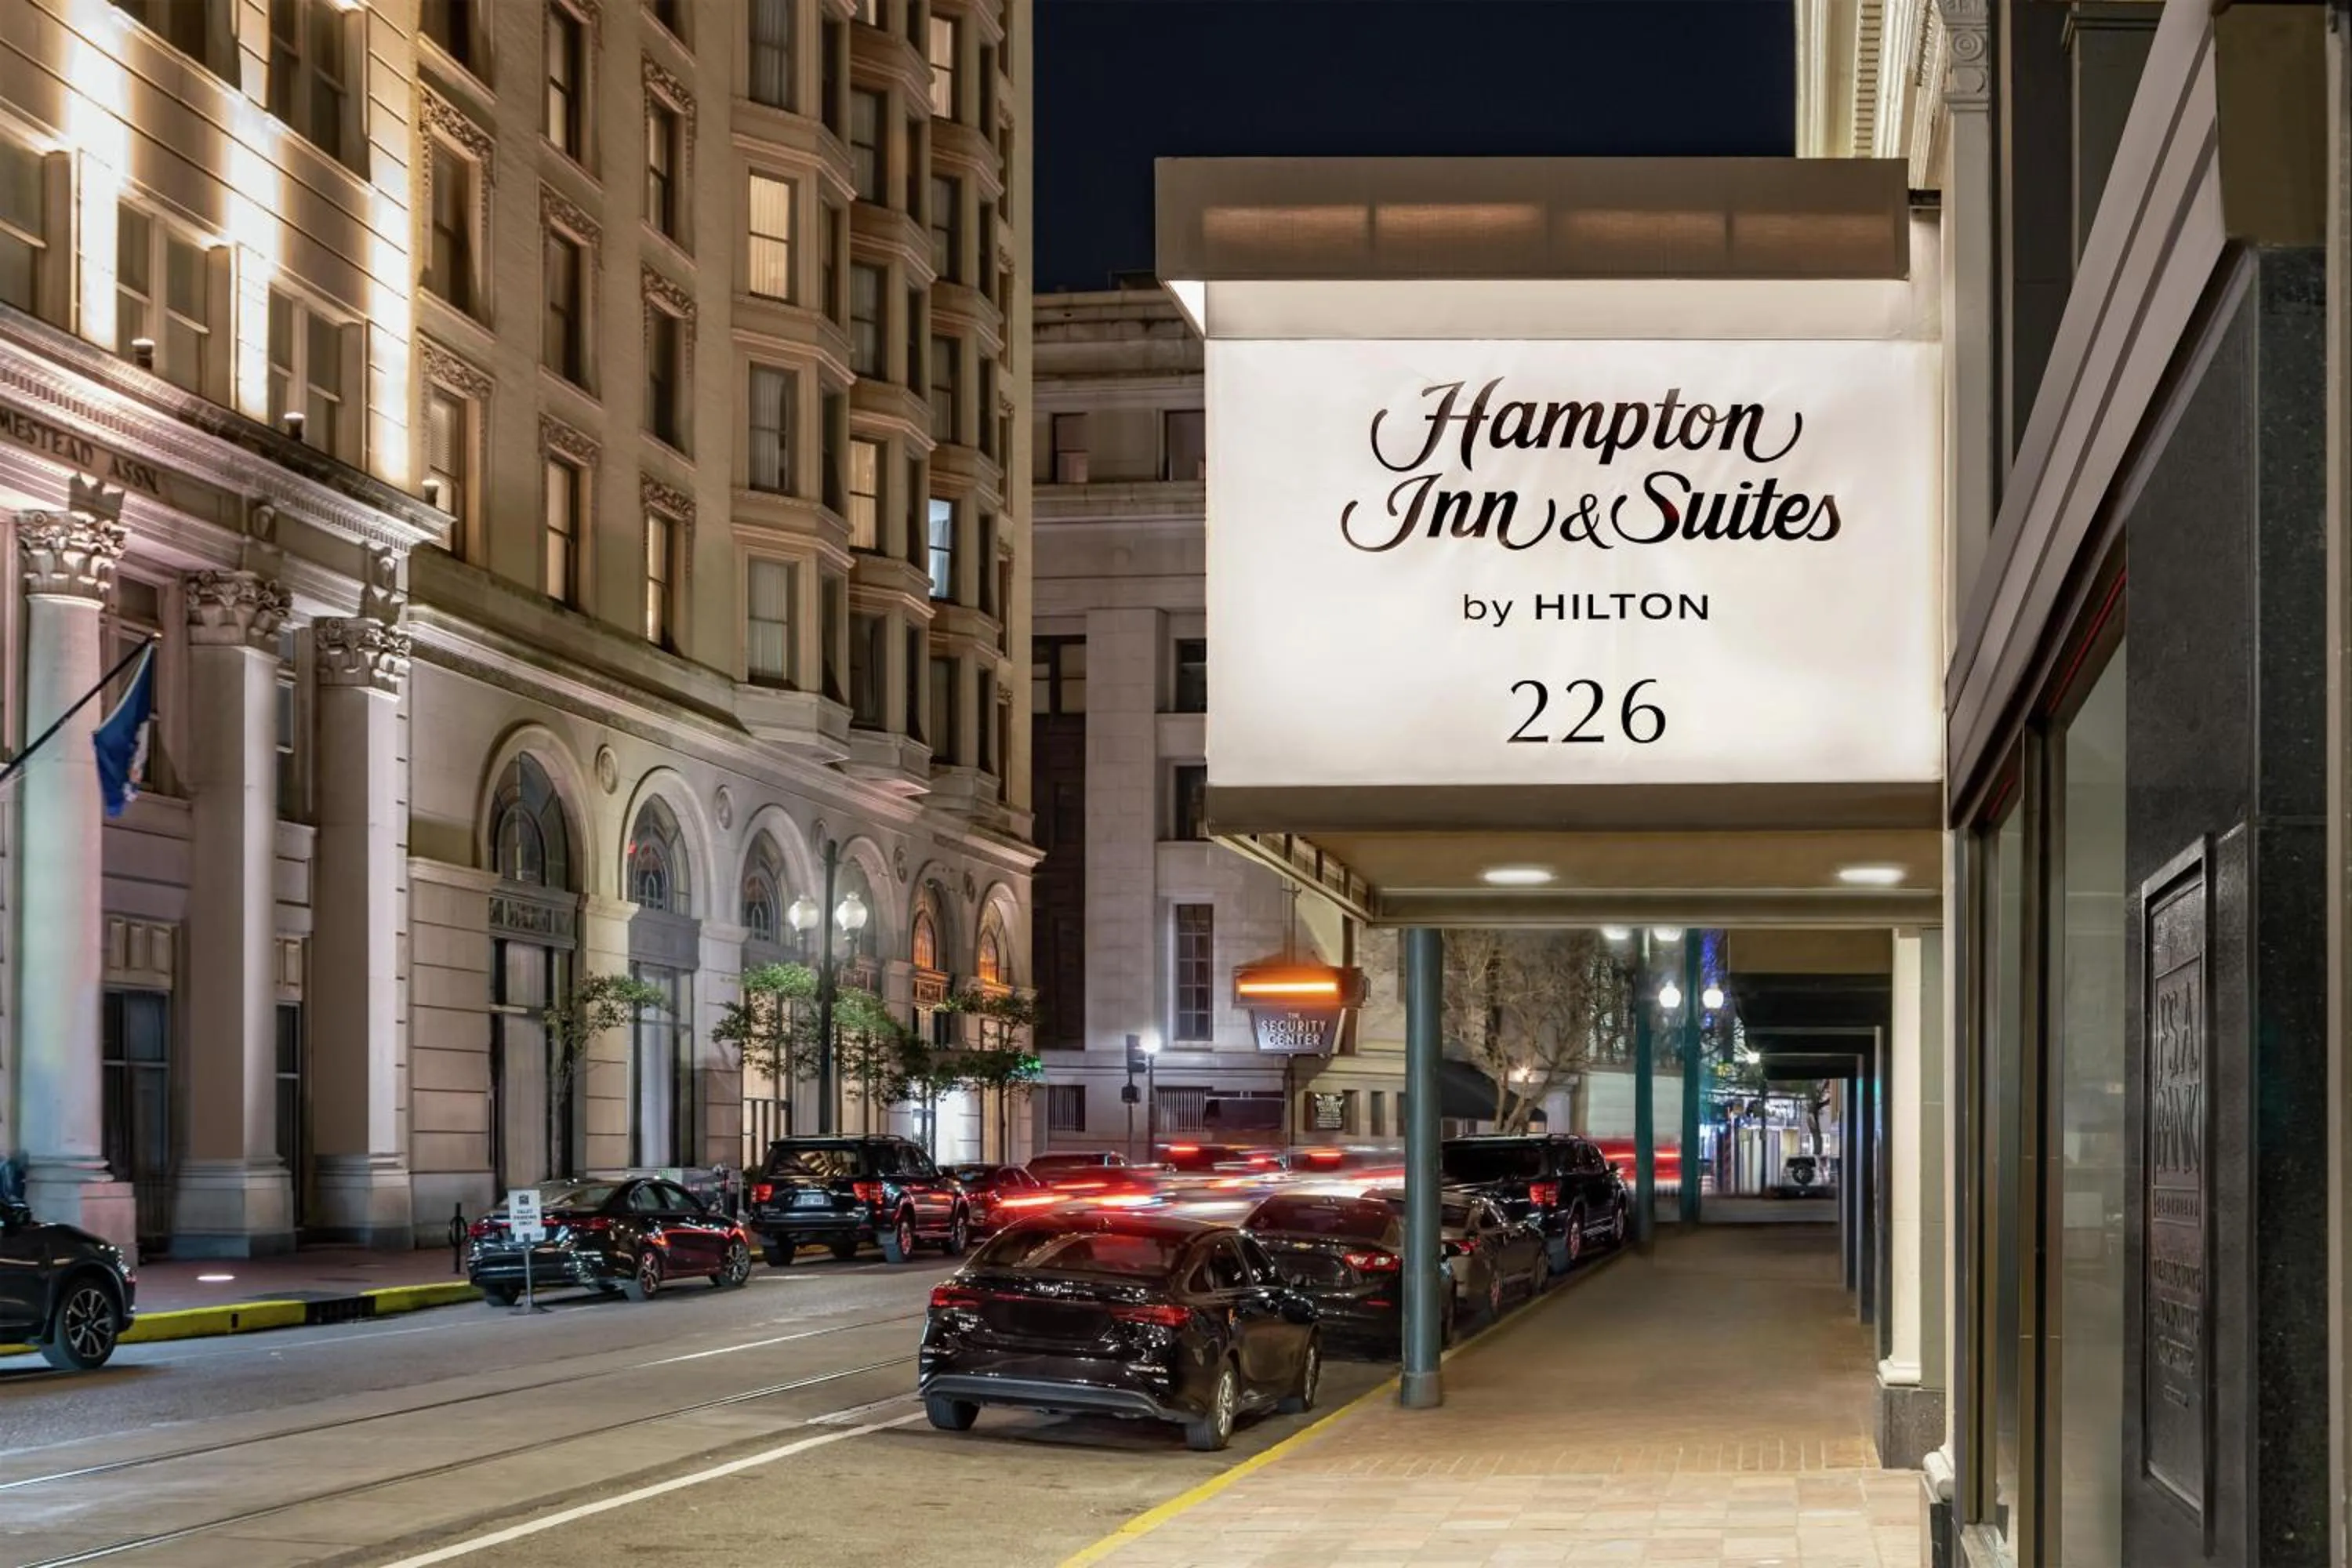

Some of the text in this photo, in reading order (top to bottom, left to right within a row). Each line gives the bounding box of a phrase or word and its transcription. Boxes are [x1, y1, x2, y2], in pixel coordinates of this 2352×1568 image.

[1370, 376, 1803, 473] Hampton
[1341, 470, 1842, 553] Inn & Suites
[1463, 593, 1709, 628] by HILTON
[1506, 678, 1667, 744] 226
[1261, 1019, 1327, 1033] SECURITY
[1267, 1033, 1322, 1046] CENTER
